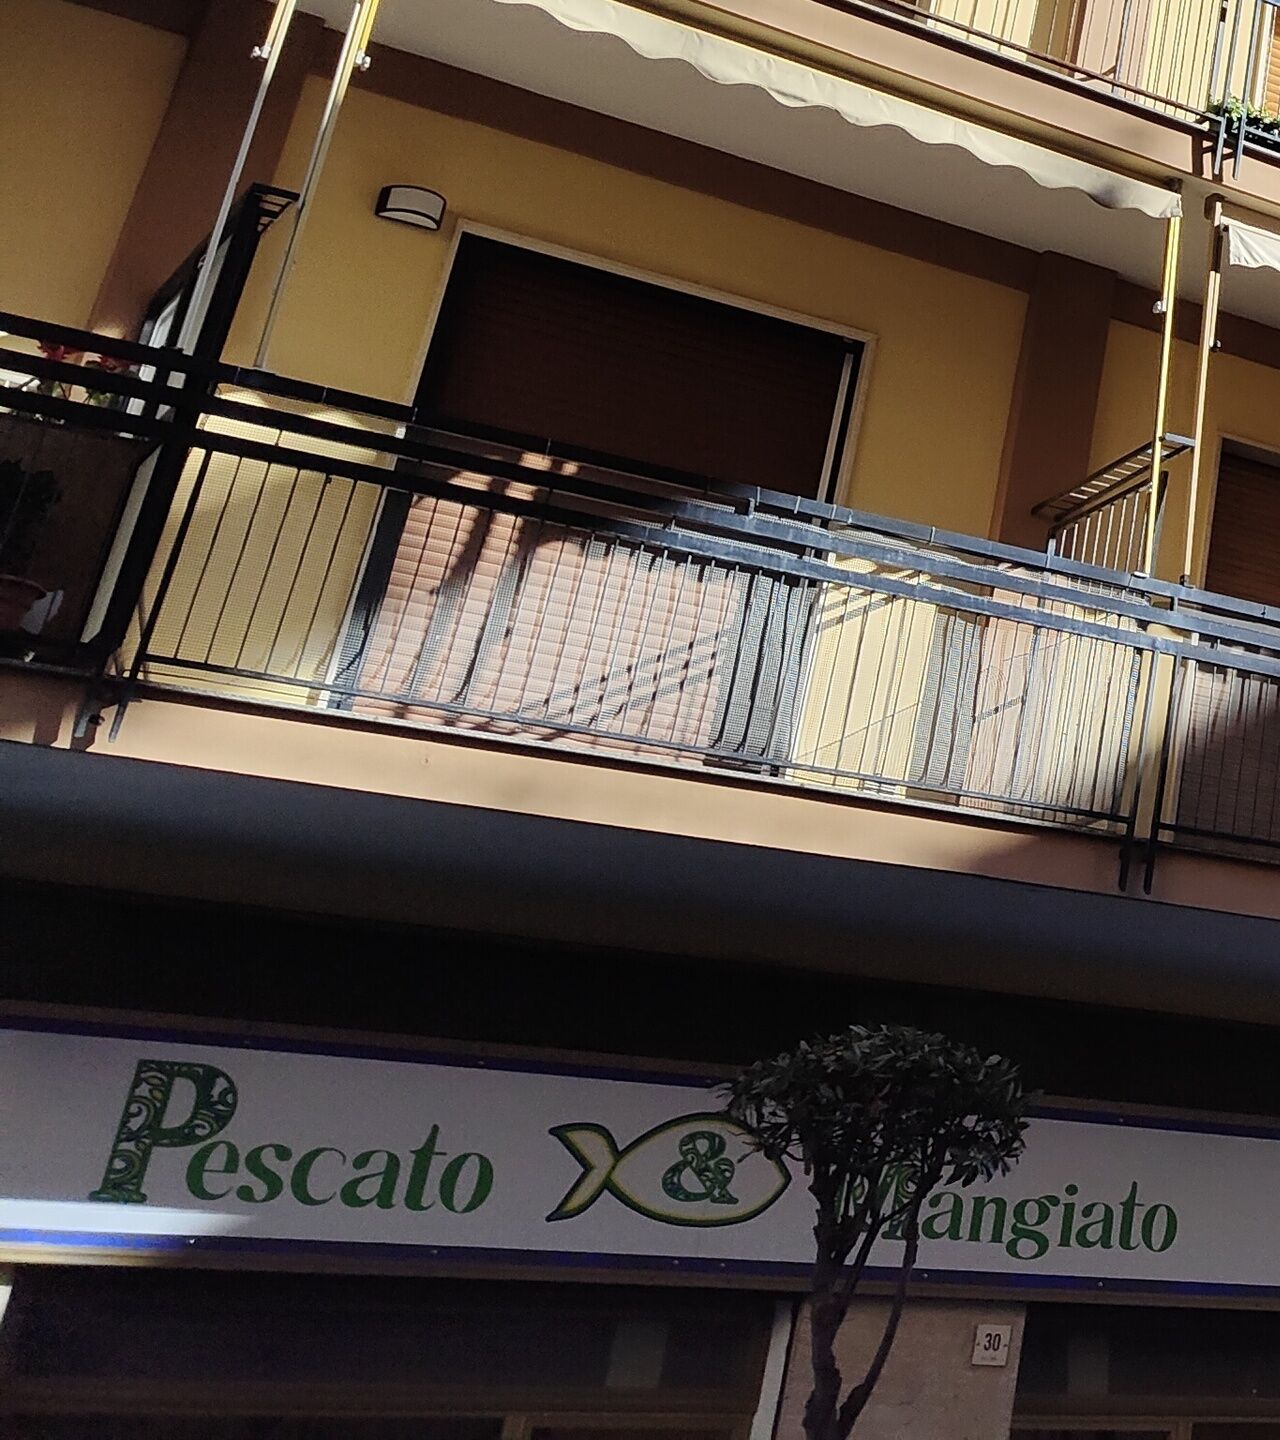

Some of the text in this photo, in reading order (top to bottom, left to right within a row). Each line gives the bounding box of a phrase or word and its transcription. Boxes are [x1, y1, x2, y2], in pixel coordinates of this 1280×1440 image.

[89, 1058, 495, 1215] Pescato
[660, 1129, 740, 1205] &
[983, 1332, 1002, 1352] 30
